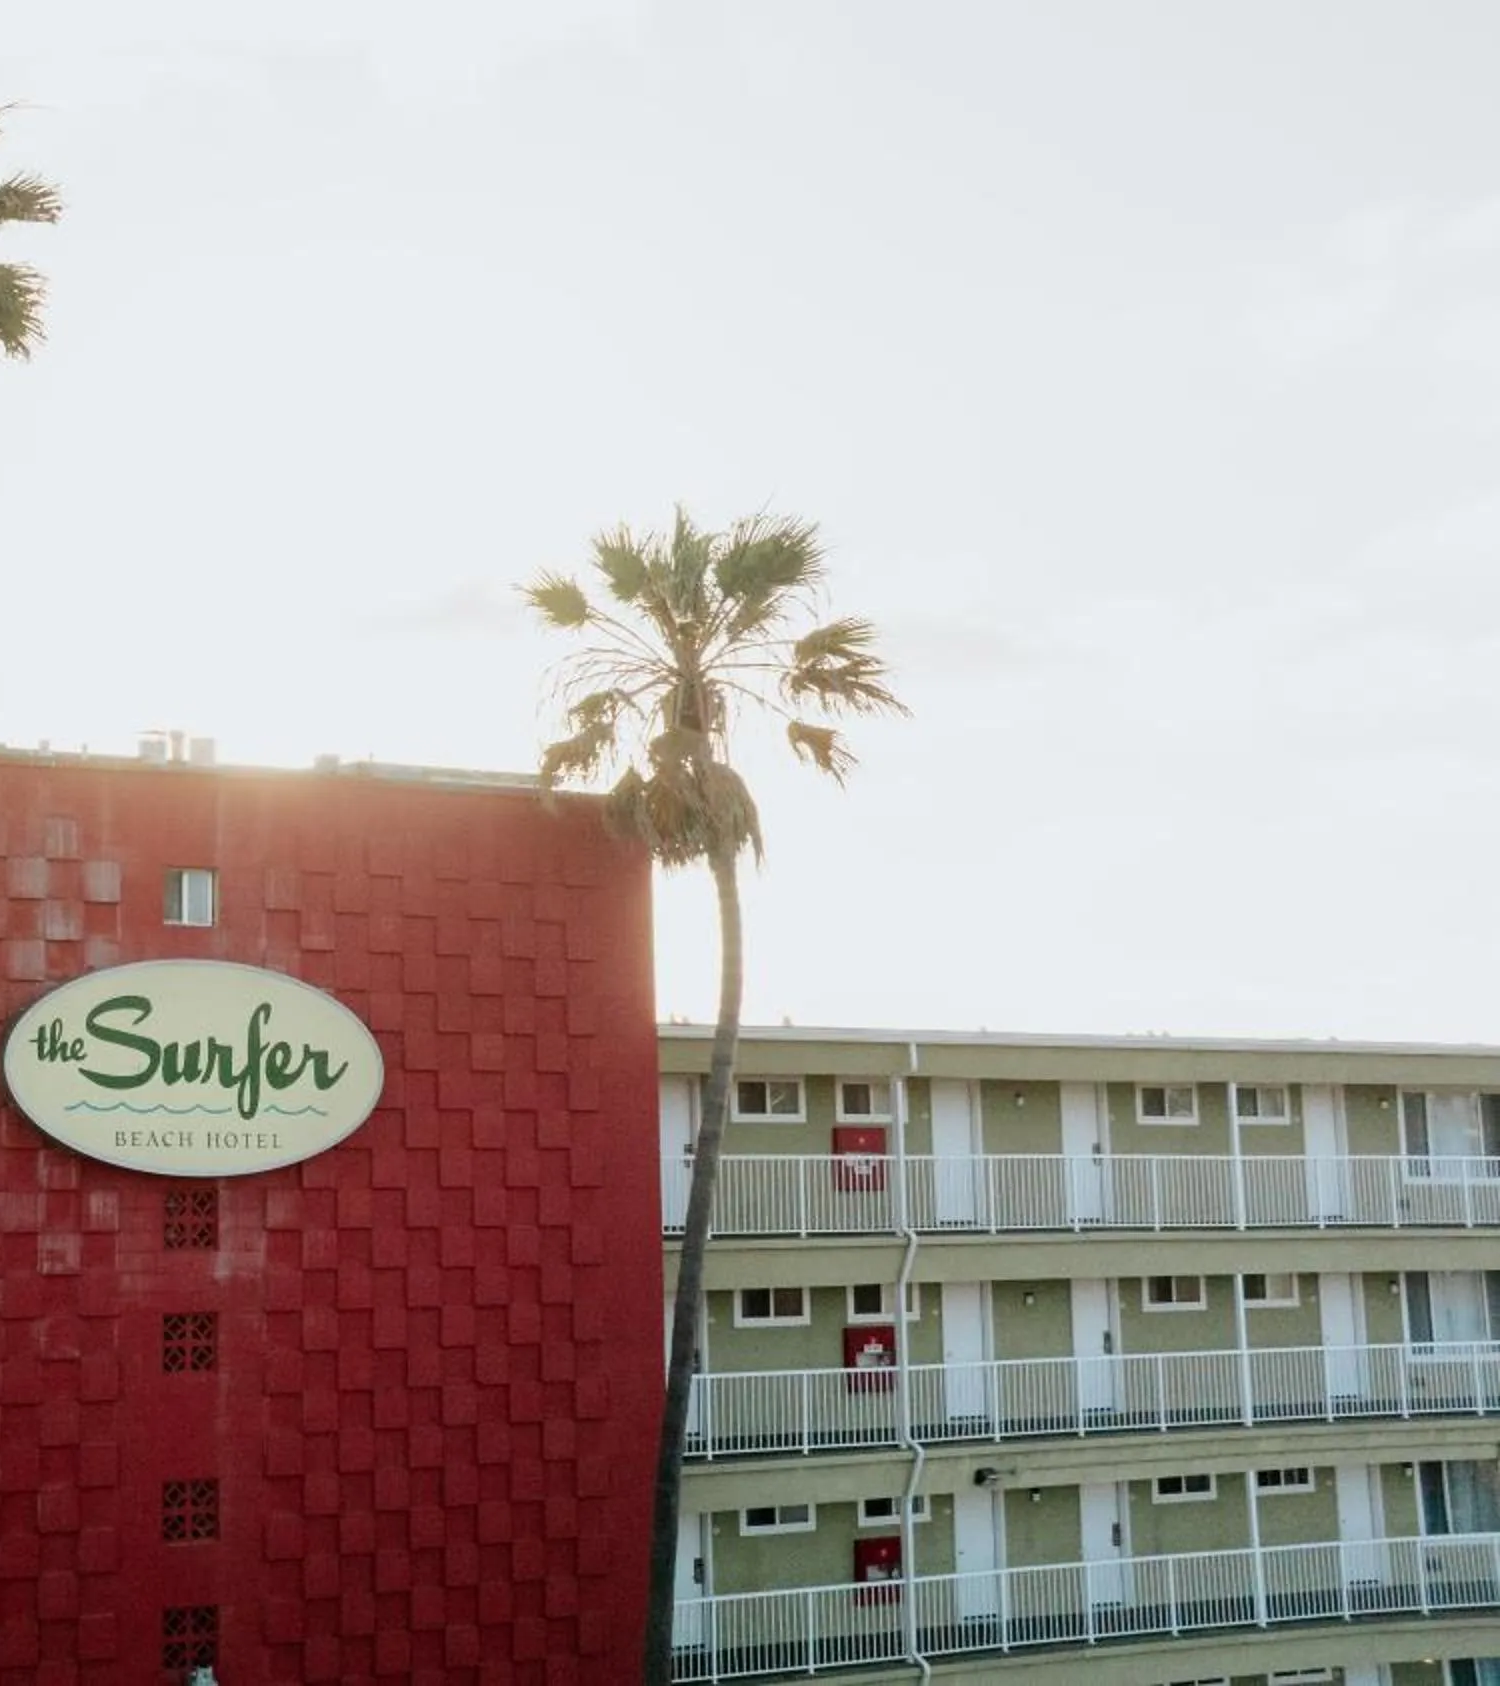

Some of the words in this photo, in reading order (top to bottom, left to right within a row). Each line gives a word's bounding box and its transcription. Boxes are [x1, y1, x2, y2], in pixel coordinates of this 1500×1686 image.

[29, 1018, 87, 1062] the
[78, 995, 348, 1120] Surfer
[114, 1131, 194, 1148] BEACH
[206, 1131, 283, 1149] HOTEL
